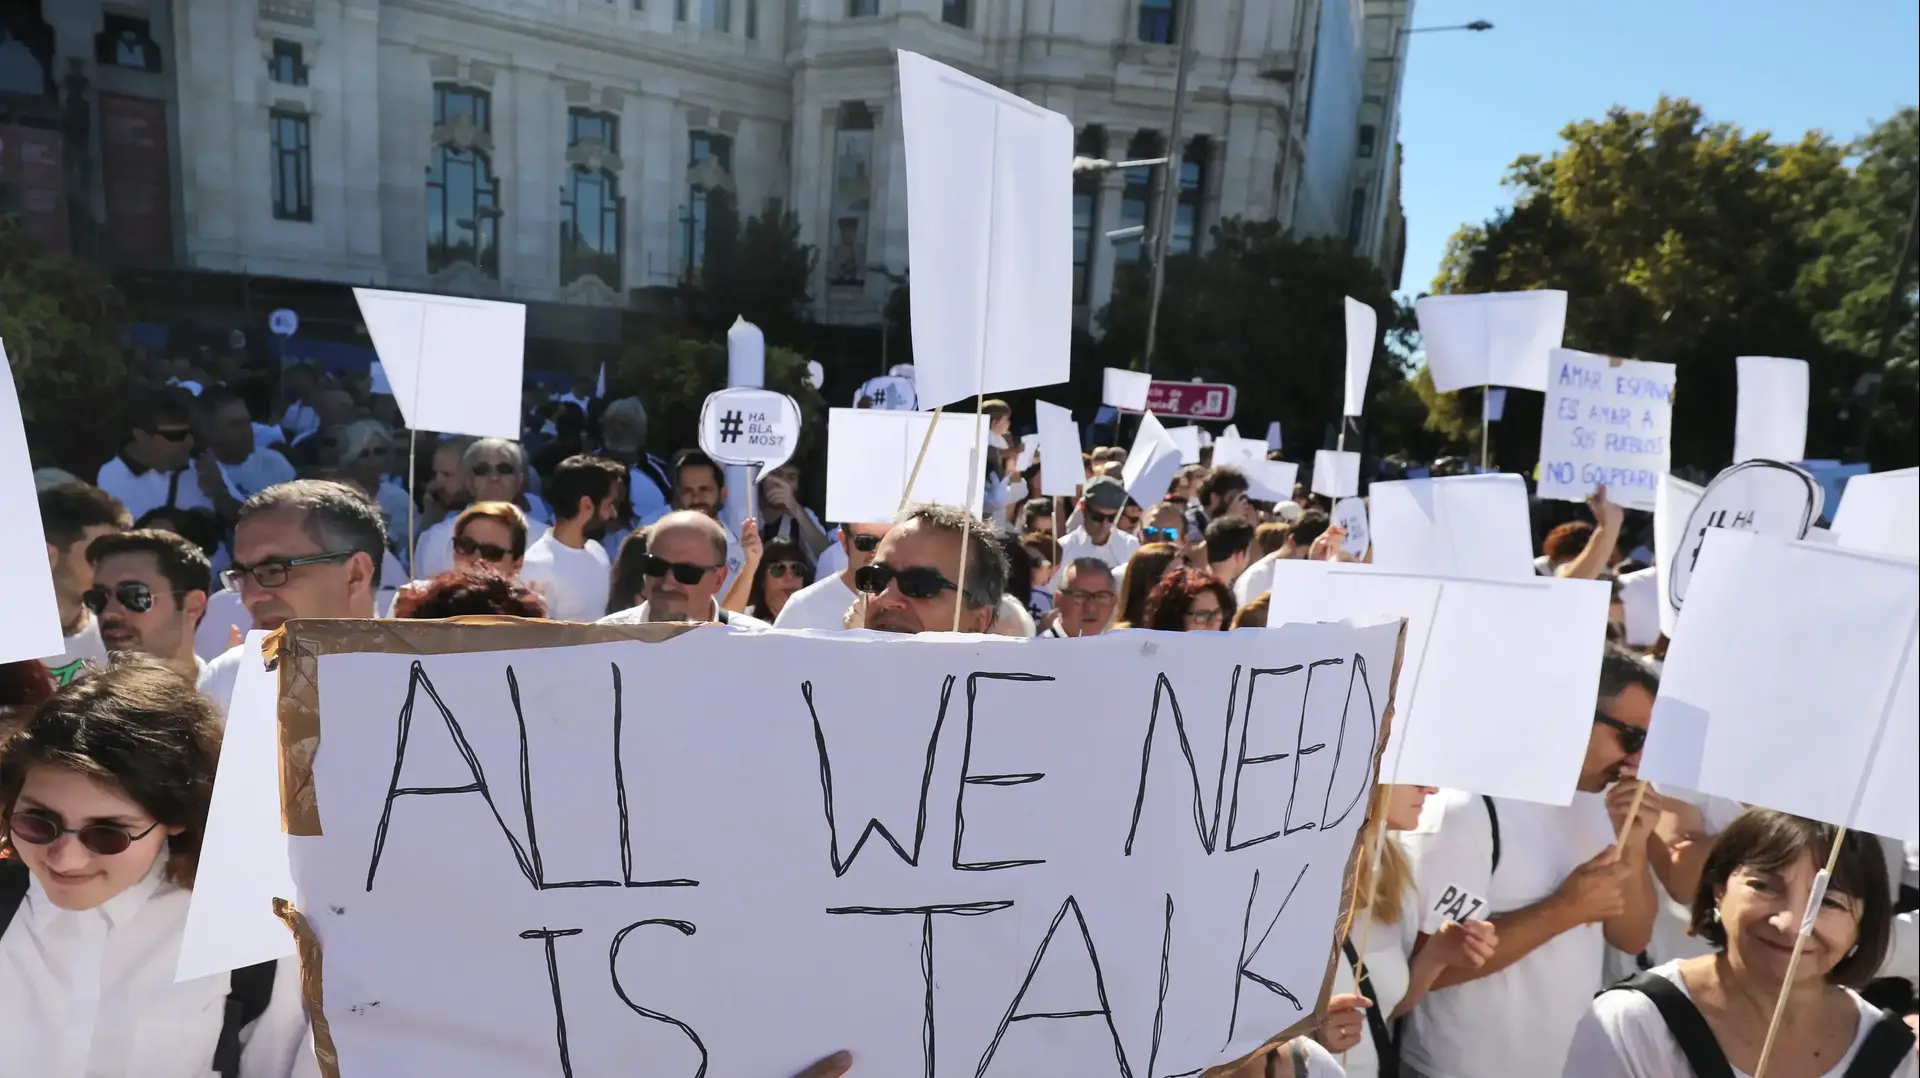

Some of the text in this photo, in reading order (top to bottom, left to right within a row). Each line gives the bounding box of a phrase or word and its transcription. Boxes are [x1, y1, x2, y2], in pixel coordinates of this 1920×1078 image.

[1558, 362, 1601, 391] AMAR
[748, 412, 765, 421] HA
[1558, 397, 1654, 429] ES AMAR A
[748, 423, 773, 434] BLA
[1547, 461, 1575, 485] NO
[367, 652, 1376, 892] ALL WE NEED
[519, 863, 1309, 1078] IS TALK
